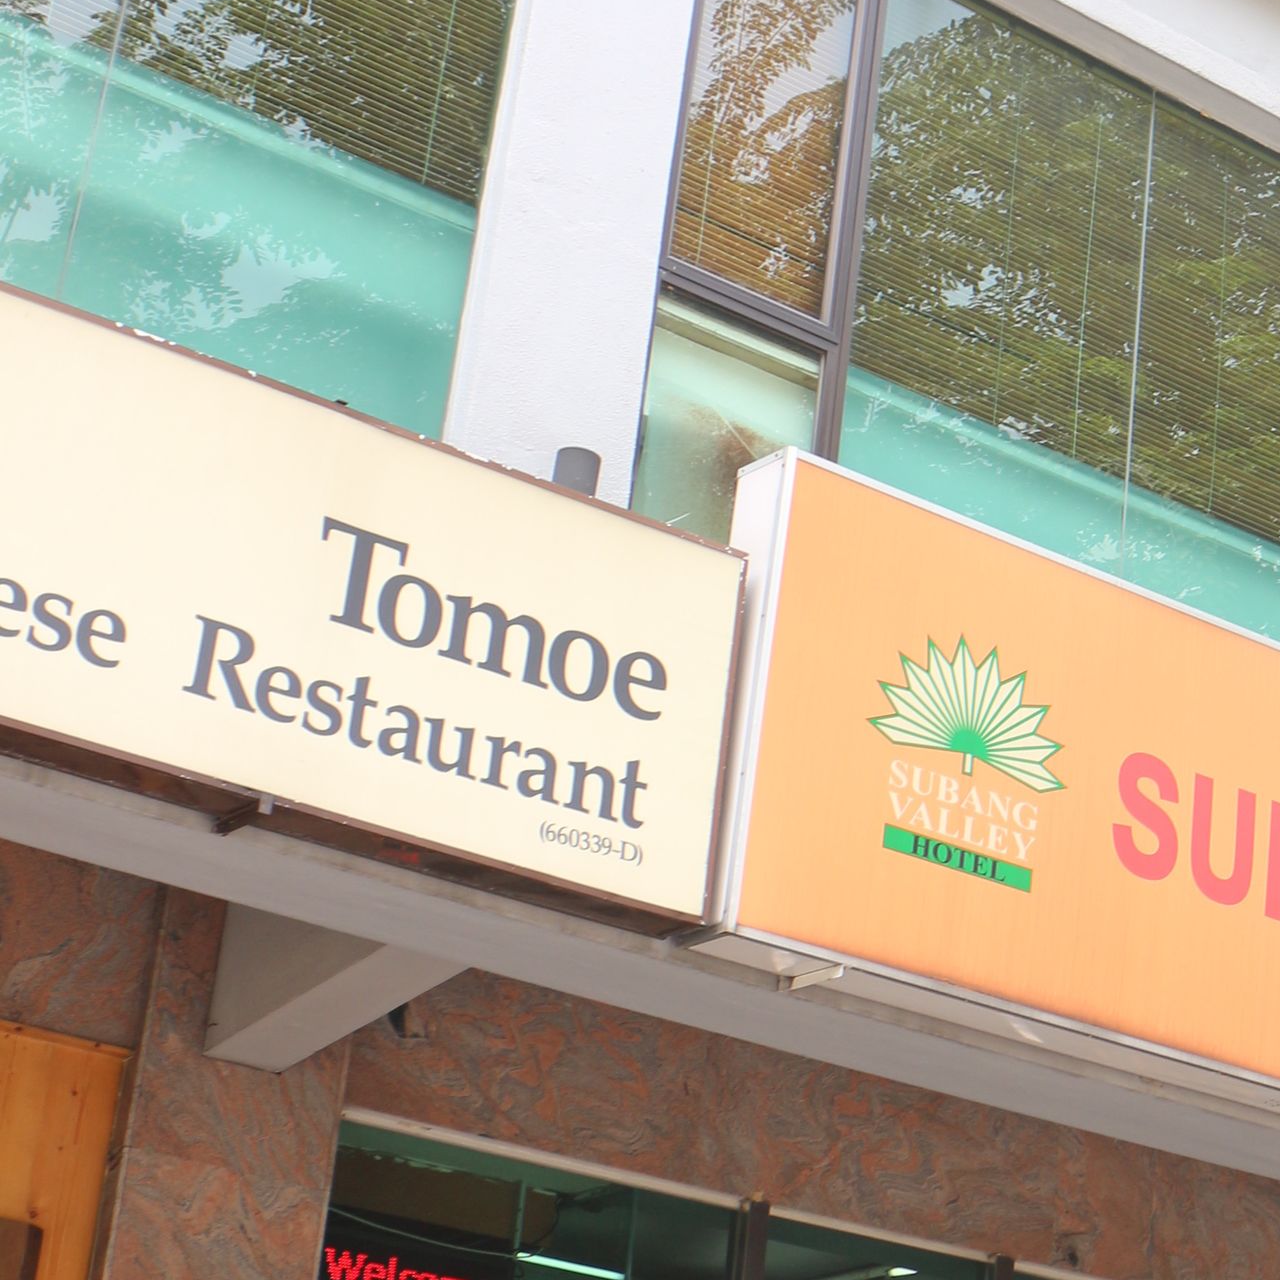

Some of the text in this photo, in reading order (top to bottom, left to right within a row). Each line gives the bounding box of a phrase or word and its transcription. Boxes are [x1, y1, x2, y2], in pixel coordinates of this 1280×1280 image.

[321, 515, 669, 721] Tomoe
[181, 613, 649, 829] Restaurant
[888, 758, 1039, 832] SUBANG
[888, 790, 1036, 862] VALLEY
[540, 820, 643, 867] (660339-D)
[911, 834, 1007, 882] HOTEL
